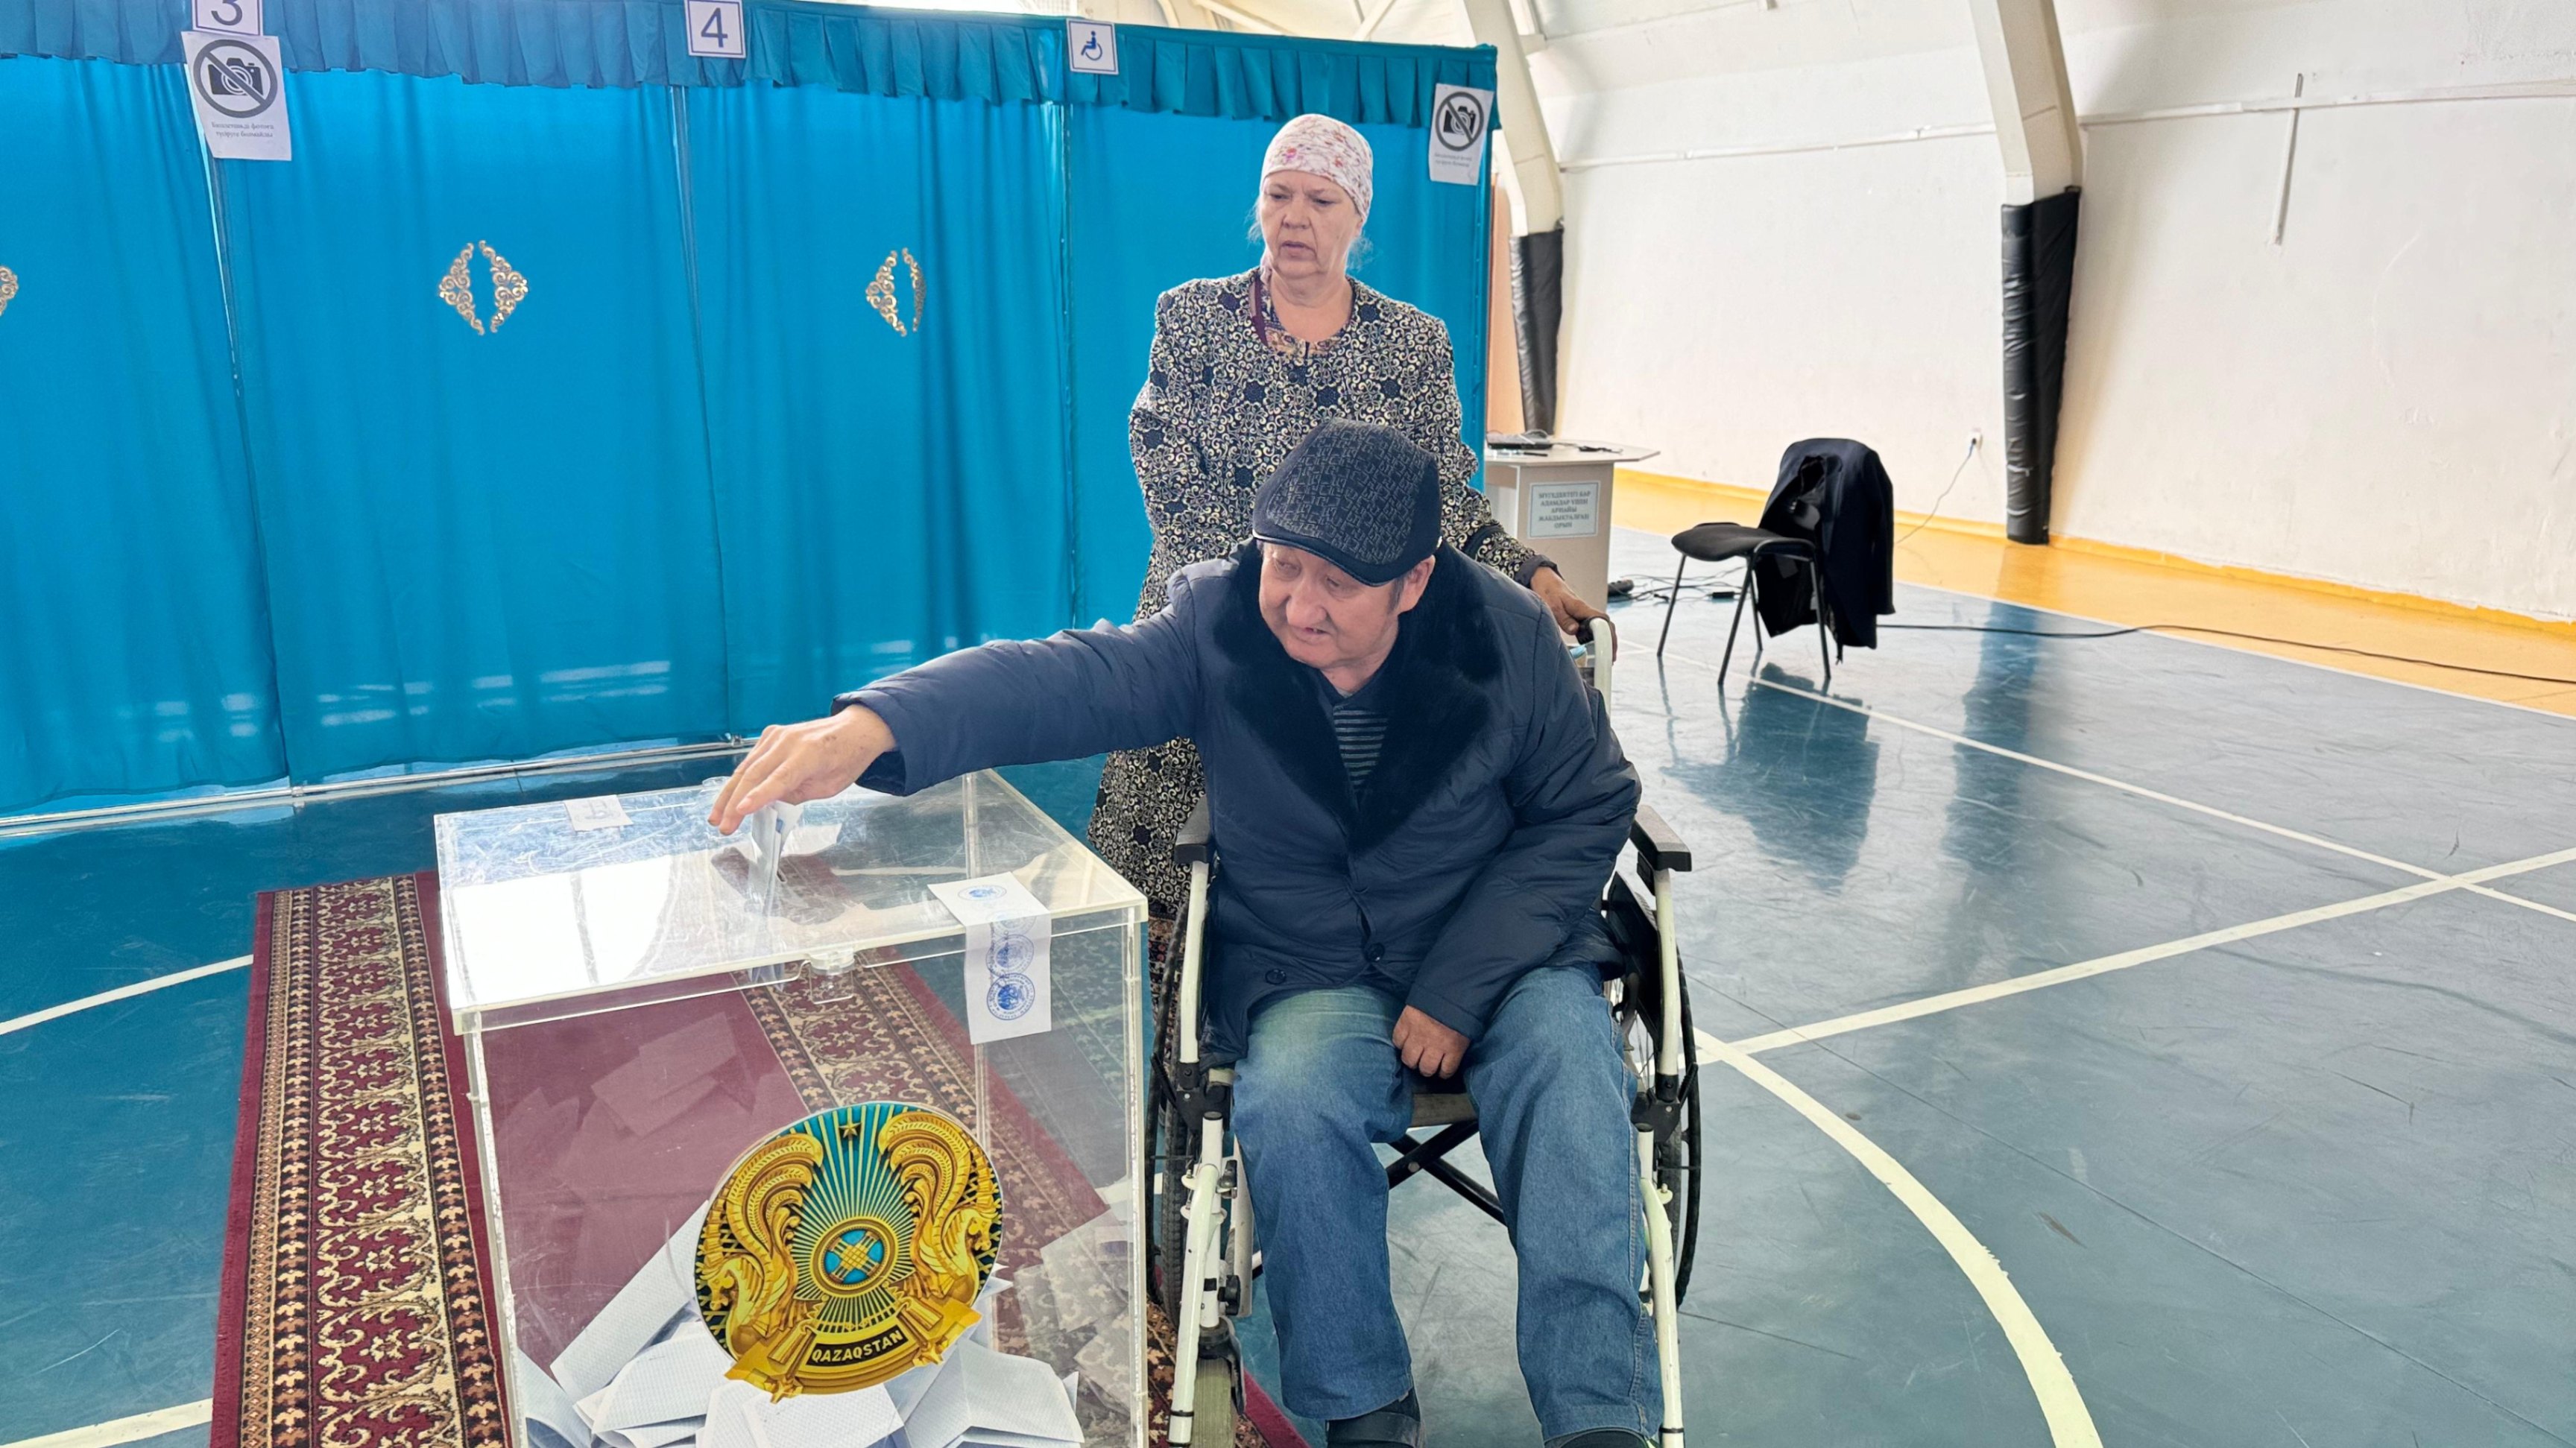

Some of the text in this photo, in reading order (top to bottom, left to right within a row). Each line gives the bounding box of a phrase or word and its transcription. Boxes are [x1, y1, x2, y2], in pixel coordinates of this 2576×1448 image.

[211, 0, 243, 26] 3
[701, 7, 728, 48] 4
[811, 1330, 904, 1363] QAZAQSTAN
